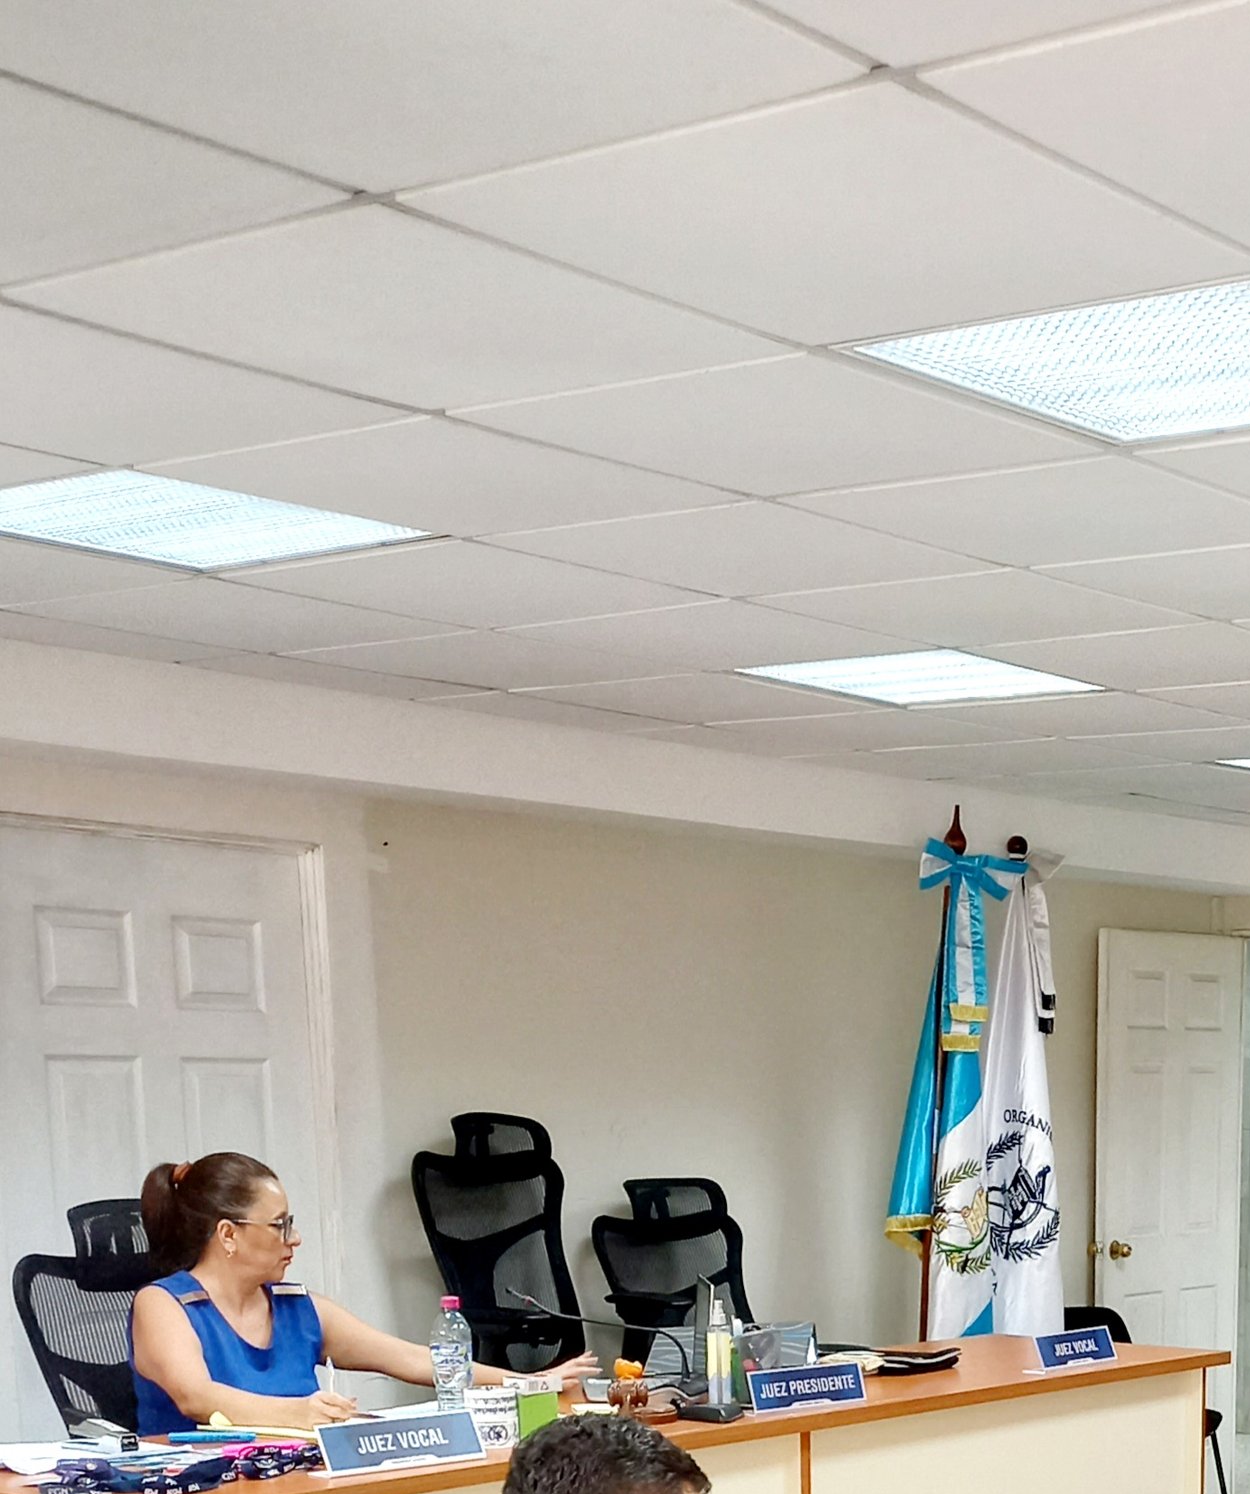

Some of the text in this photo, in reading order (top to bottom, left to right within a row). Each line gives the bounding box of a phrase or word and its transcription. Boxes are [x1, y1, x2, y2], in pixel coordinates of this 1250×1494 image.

[1053, 1338, 1099, 1357] JUEZ VOCAL
[760, 1374, 857, 1399] JUEZ PRESIDENTE
[358, 1427, 450, 1455] JUEZ VOCAL
